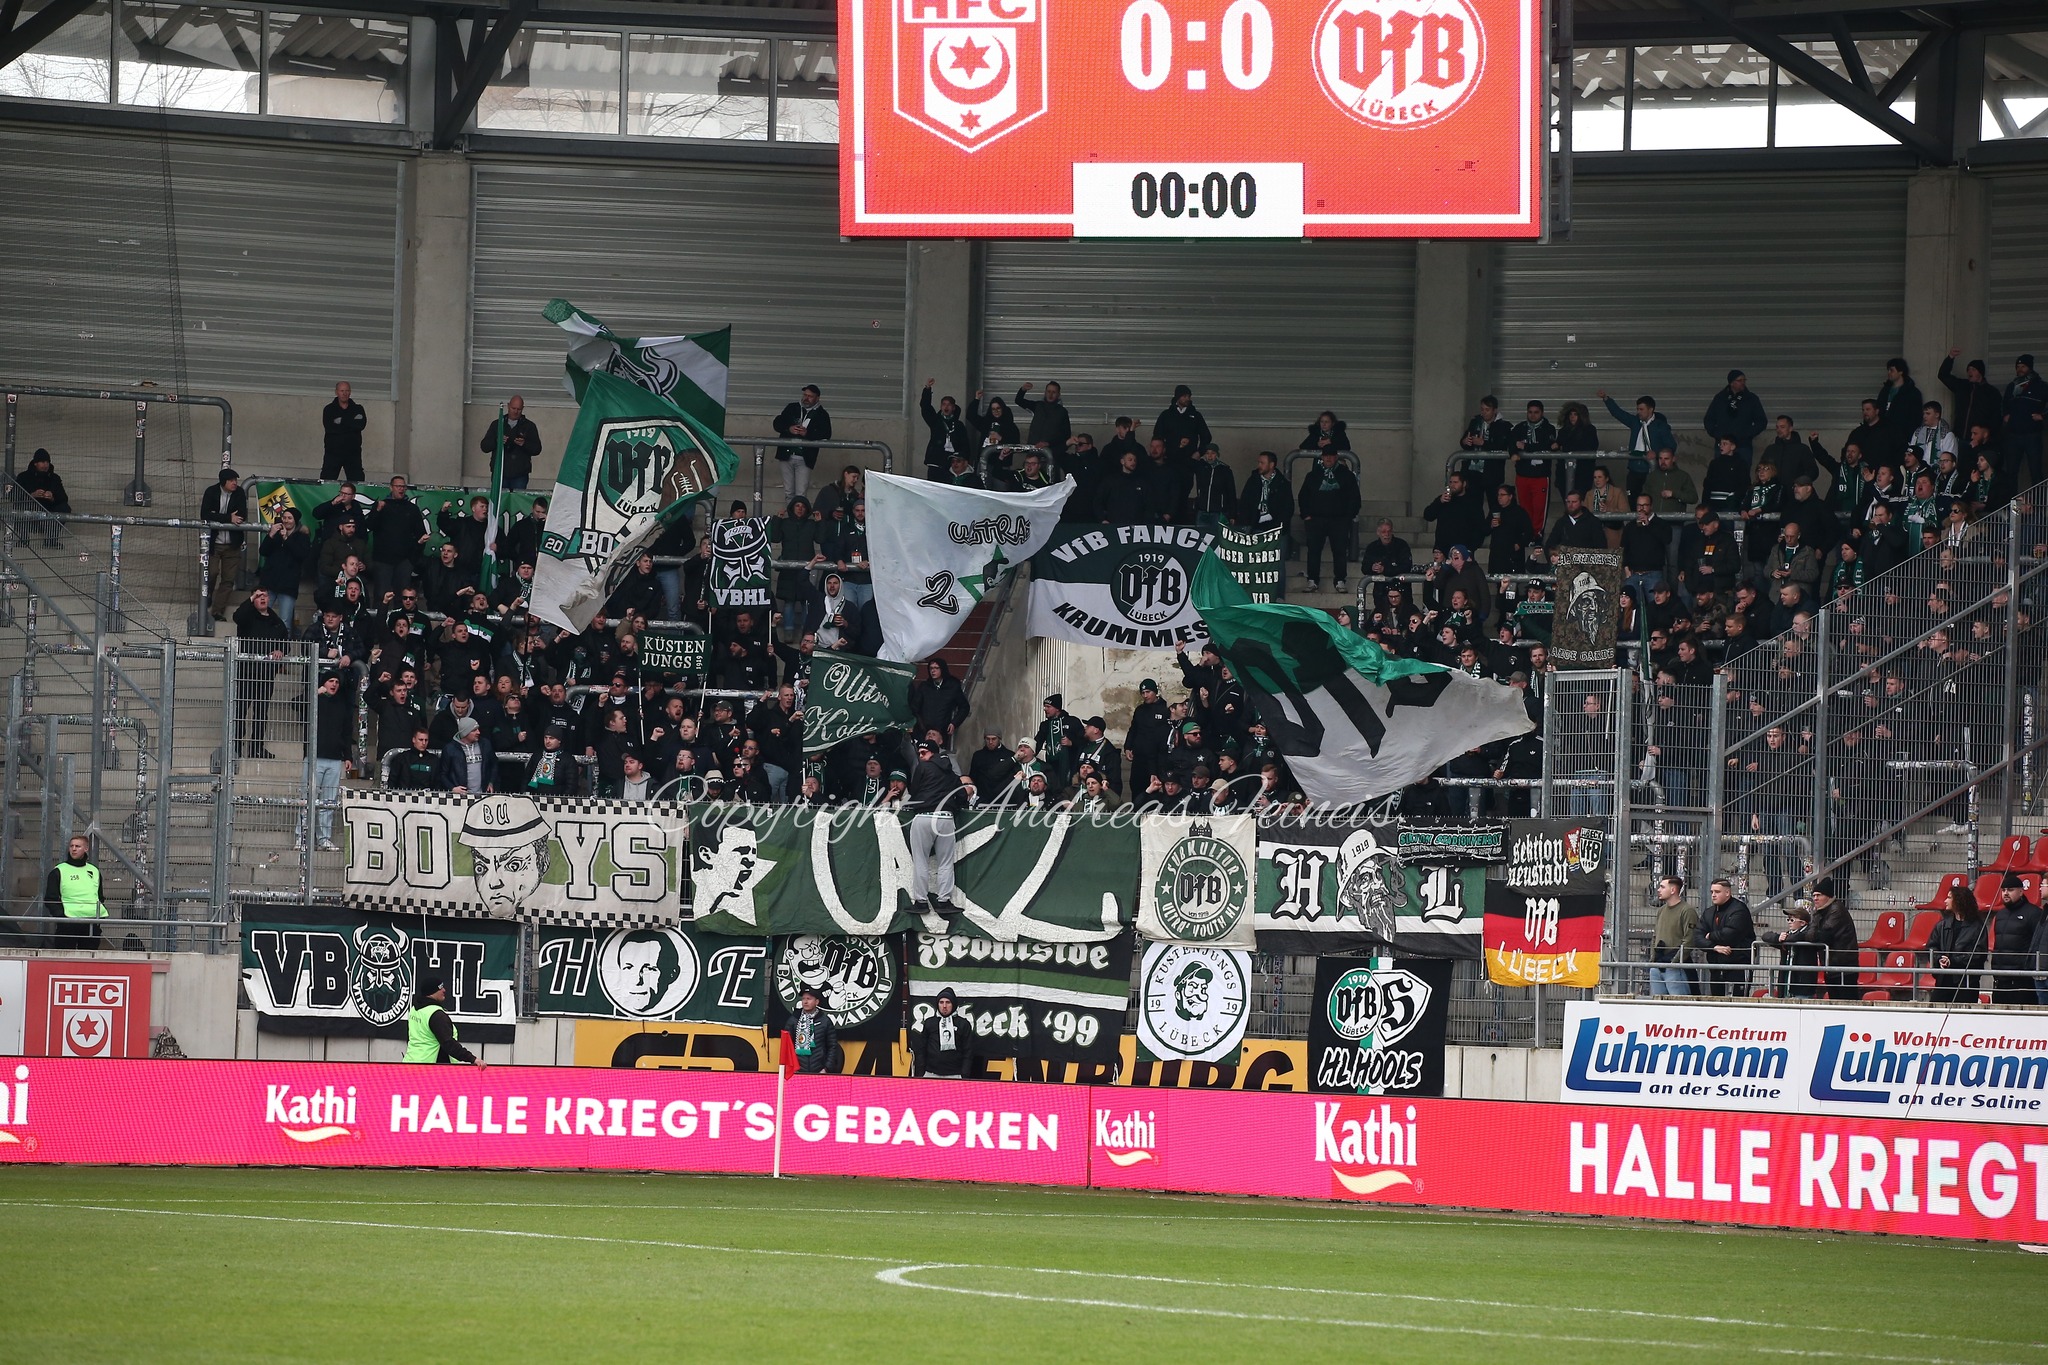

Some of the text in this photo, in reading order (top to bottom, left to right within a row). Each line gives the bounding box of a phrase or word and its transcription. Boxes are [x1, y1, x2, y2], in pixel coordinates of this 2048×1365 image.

[1119, 0, 1274, 91] 0:0
[1356, 97, 1439, 121] LÜBECK
[1131, 171, 1257, 219] 00:00
[578, 530, 614, 558] BO
[1051, 531, 1110, 563] VfB
[1222, 527, 1258, 545] ULTRAS
[1138, 553, 1165, 564] 1919
[1219, 547, 1281, 563] NSER LEBEN
[713, 588, 771, 606] VBHL
[1118, 562, 1181, 611] VfB
[1052, 601, 1212, 648] KRUMMES
[1128, 608, 1168, 622] LÜBECK
[643, 636, 706, 653] KÜSTEN
[641, 652, 692, 669] JUNGS
[695, 655, 704, 670] 1919
[1167, 840, 1240, 876] SUBKULTUR
[1351, 840, 1370, 859] 1919
[1180, 872, 1222, 908] VfB
[1524, 897, 1560, 950] VfB
[252, 931, 350, 1008] VB
[1497, 941, 1579, 983] LÜBECK
[777, 963, 796, 1002] BAD
[1348, 974, 1368, 985] 1919
[58, 984, 120, 1004] HFC
[1150, 999, 1161, 1009] 19
[1226, 1002, 1238, 1013] 19
[1336, 985, 1377, 1026] VfB
[1159, 1021, 1223, 1047] LÜBECK
[1342, 1023, 1369, 1035] LÜBECK
[1645, 1023, 1788, 1042] Wohn-Centrum
[1893, 1031, 2048, 1051] Wohn-Centrum
[1351, 1046, 1424, 1089] HOOLS
[1565, 1016, 1789, 1094] Lührmann
[1809, 1024, 2048, 1104] Lührmann
[1649, 1081, 1781, 1099] an der Saline
[1898, 1092, 2041, 1111] an der Saline
[265, 1084, 357, 1125] Kathi
[390, 1094, 528, 1134] HALLE
[794, 1104, 1059, 1152] GEBACKEN
[1095, 1109, 1156, 1149] Kathi
[1314, 1101, 1418, 1166] Kathi
[1569, 1121, 1771, 1205] HALLE
